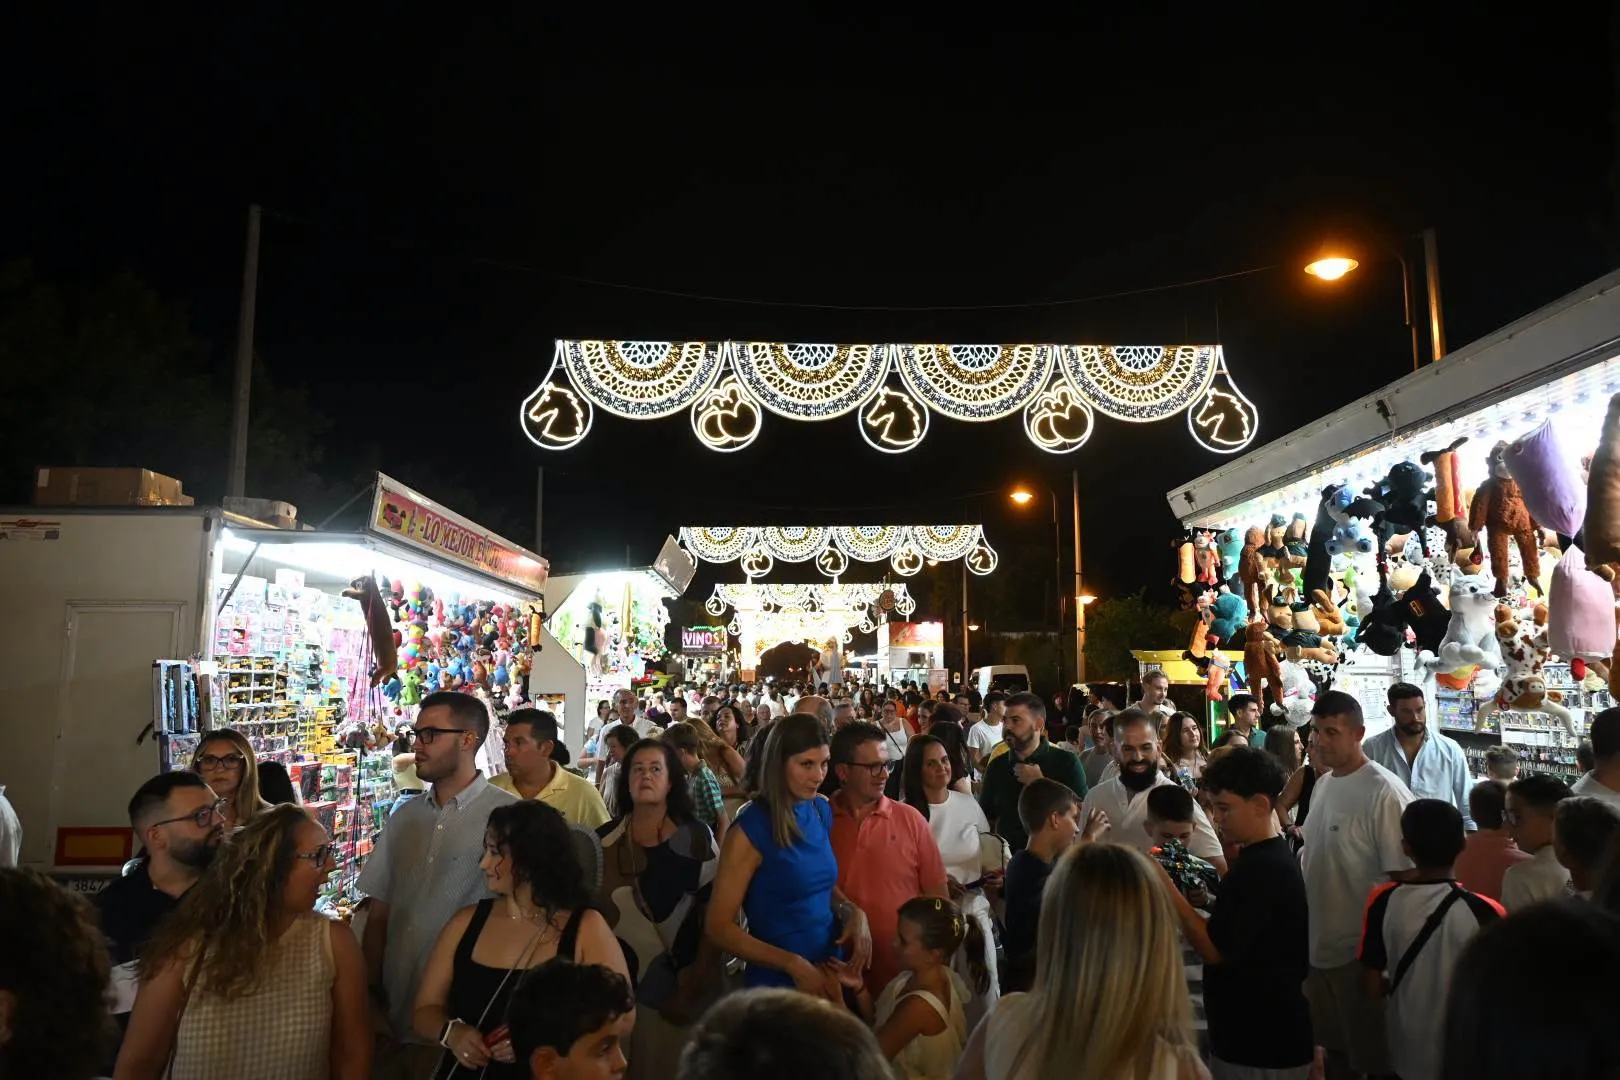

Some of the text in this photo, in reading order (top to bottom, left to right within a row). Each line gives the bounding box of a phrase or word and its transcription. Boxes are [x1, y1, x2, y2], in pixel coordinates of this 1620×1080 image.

[440, 523, 476, 559] MEJOR
[684, 631, 720, 646] VINOS
[73, 879, 104, 892] 3847
